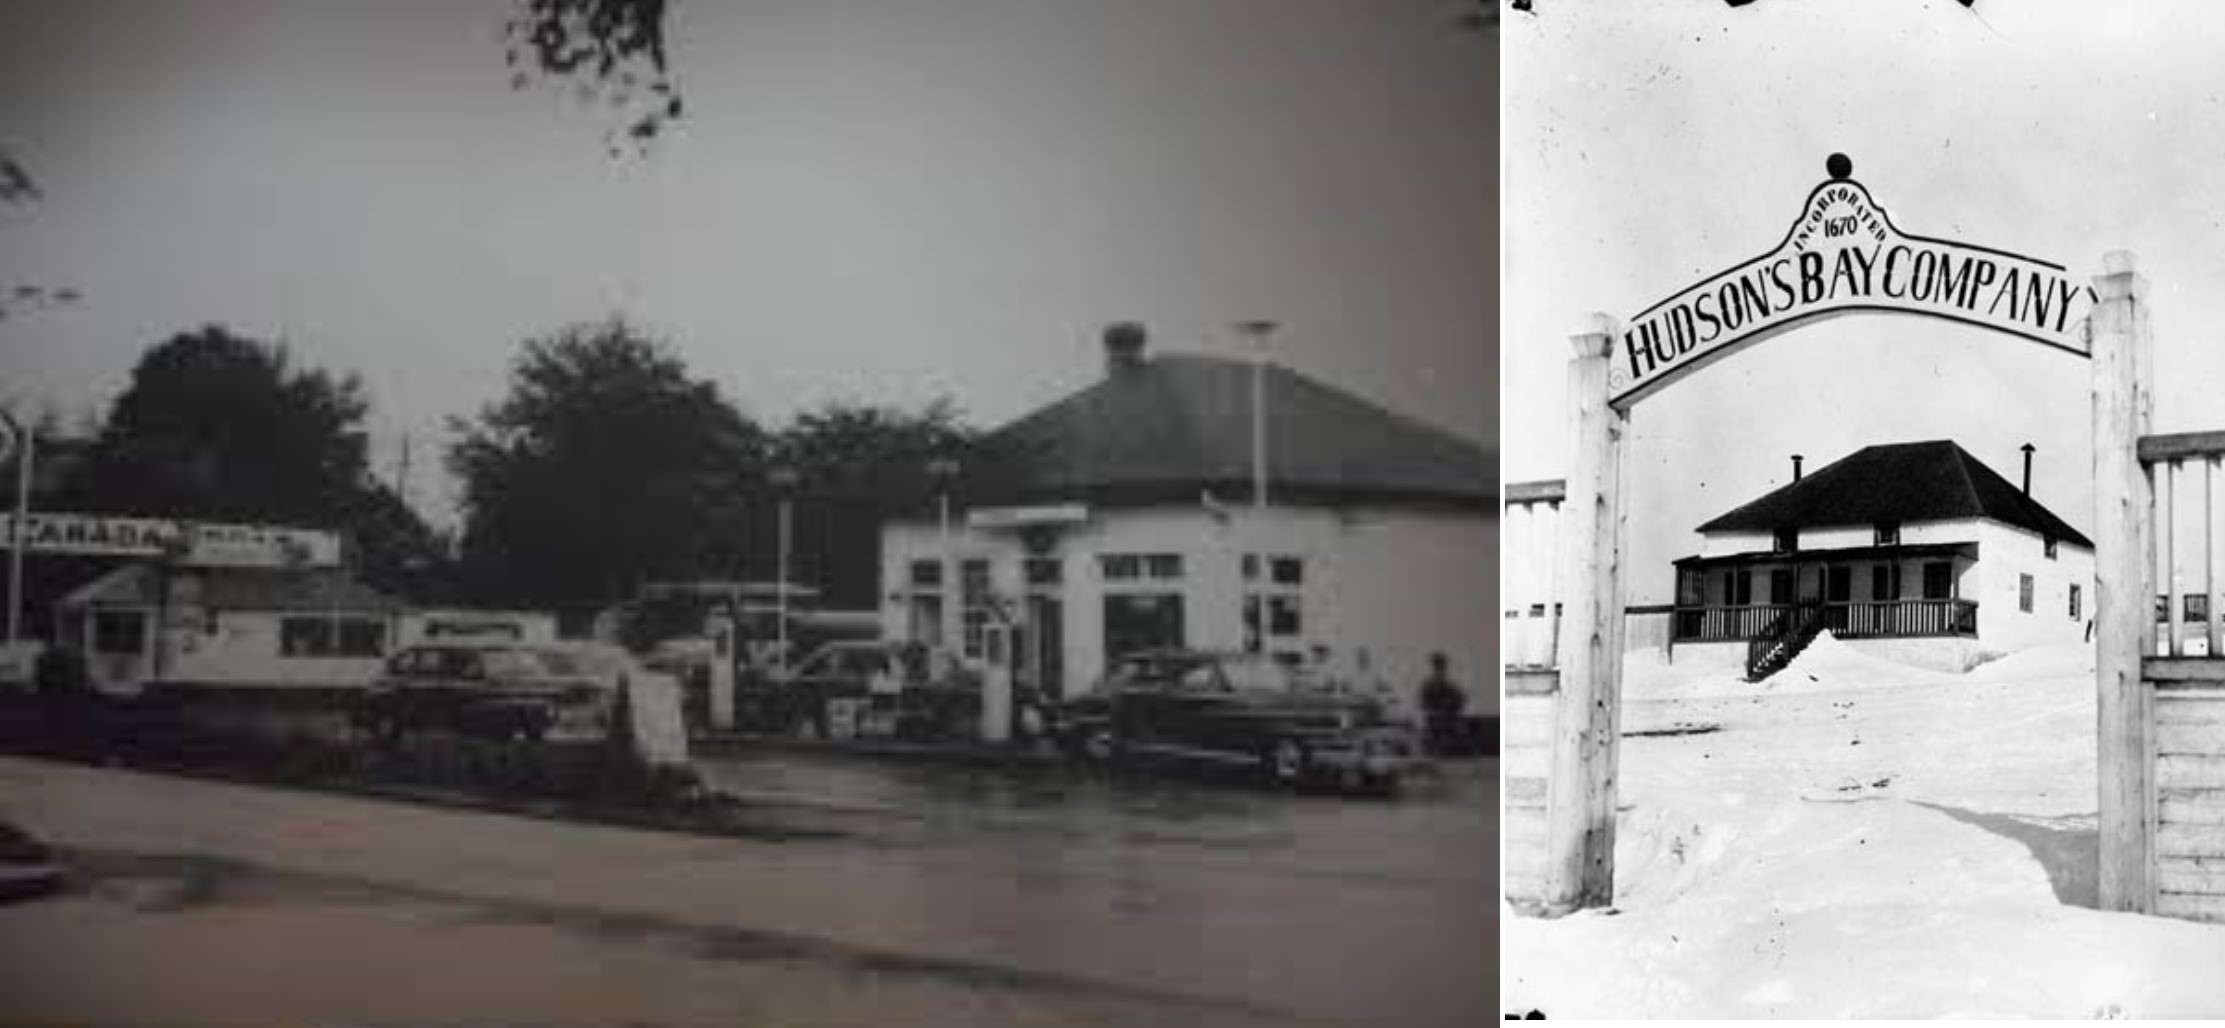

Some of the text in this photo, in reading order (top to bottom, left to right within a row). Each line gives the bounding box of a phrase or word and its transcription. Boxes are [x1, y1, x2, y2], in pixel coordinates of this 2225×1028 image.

[1793, 187, 1887, 251] INCORPORATED
[1824, 215, 1858, 238] 1670
[1625, 245, 2080, 378] HUDSON'S BAY COMPANY
